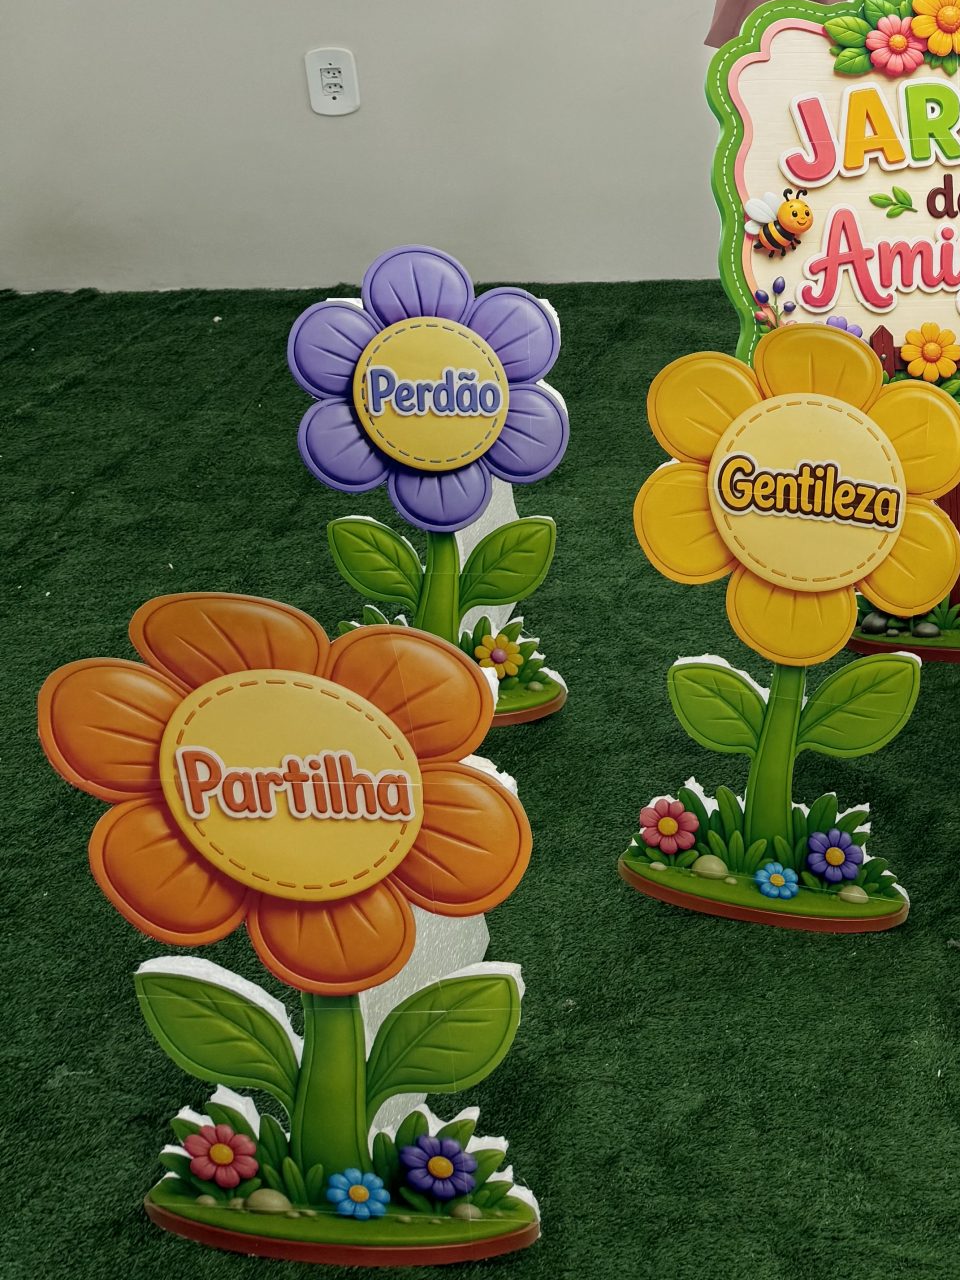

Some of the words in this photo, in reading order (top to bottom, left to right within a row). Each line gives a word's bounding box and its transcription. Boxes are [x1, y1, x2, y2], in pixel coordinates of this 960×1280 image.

[369, 368, 501, 414] Perdão
[718, 454, 901, 528] Gentileza
[181, 750, 411, 816] Partilha
